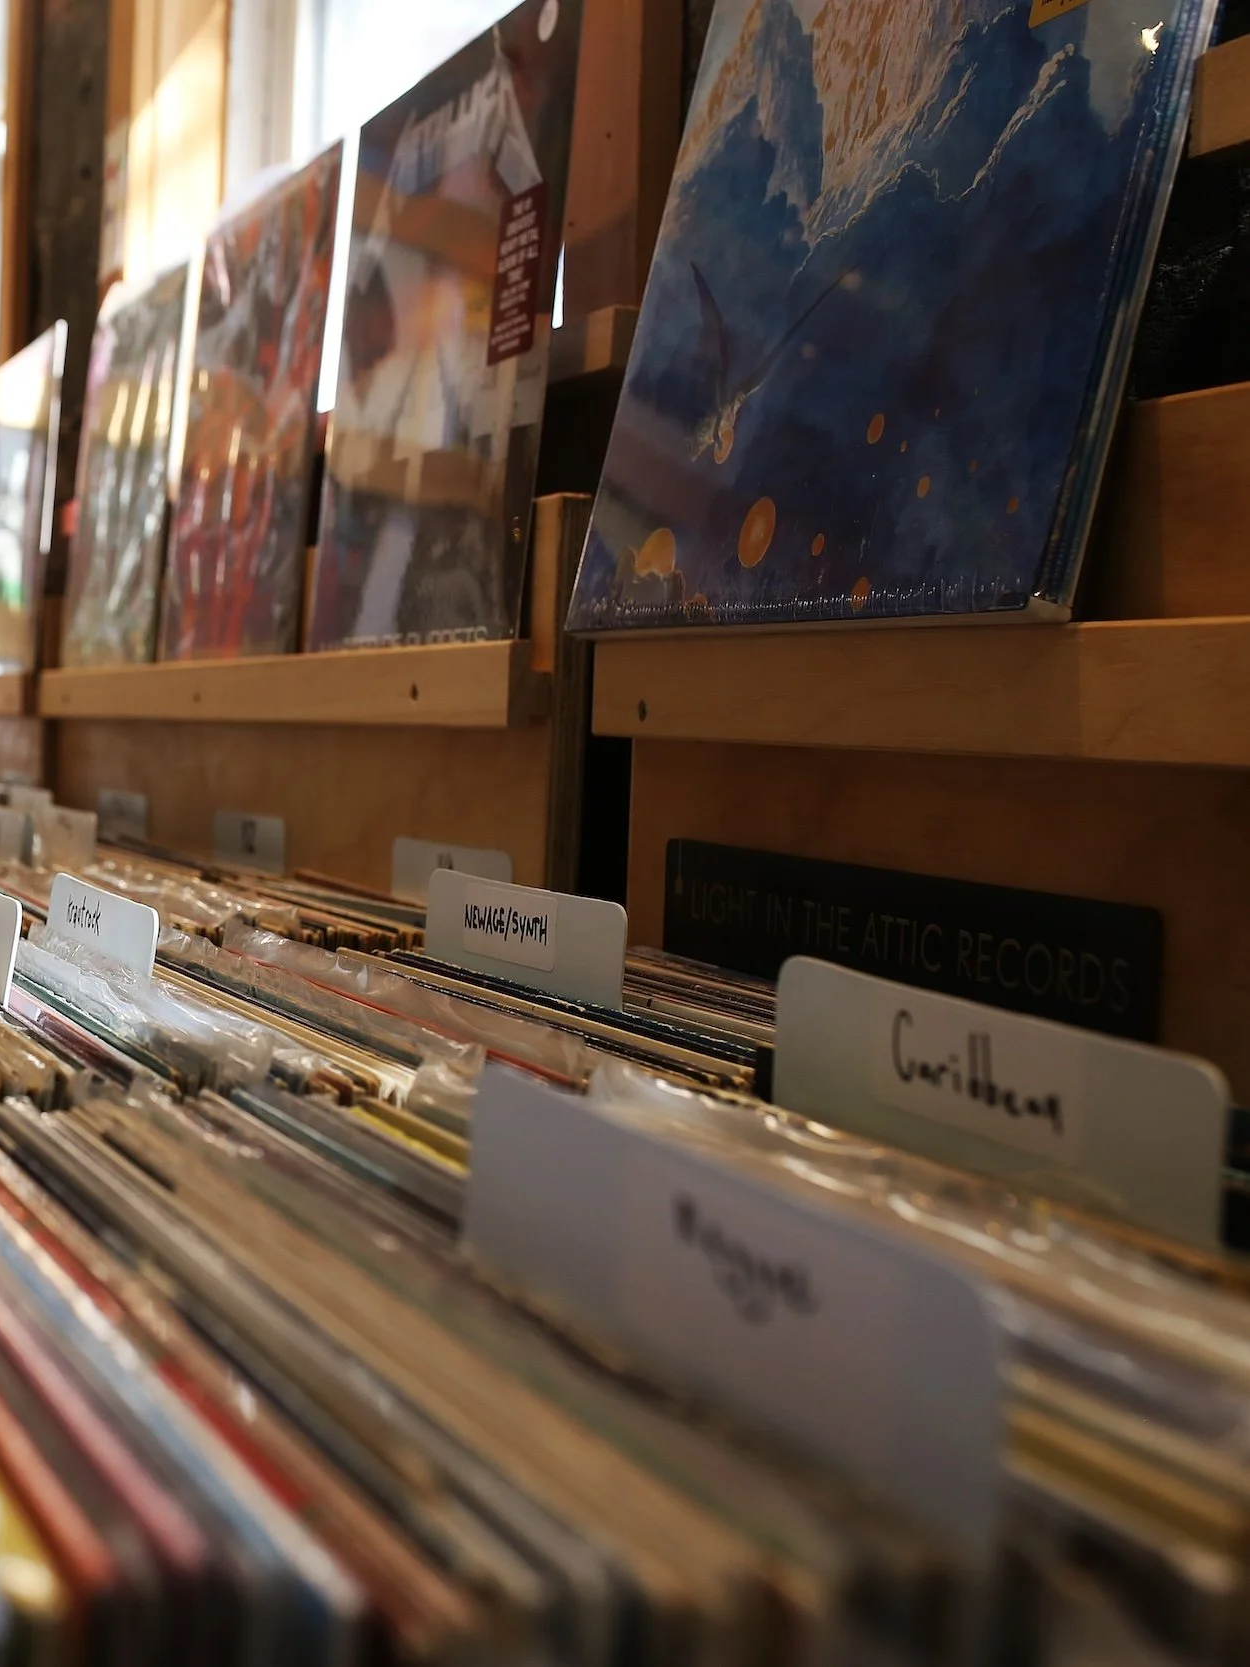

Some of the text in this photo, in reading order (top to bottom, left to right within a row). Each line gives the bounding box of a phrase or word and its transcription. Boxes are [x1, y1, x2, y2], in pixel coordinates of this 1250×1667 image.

[689, 879, 1132, 1014] LIGHT IN THE ATTIC RECORDS
[891, 1007, 1065, 1137] Caribbean
